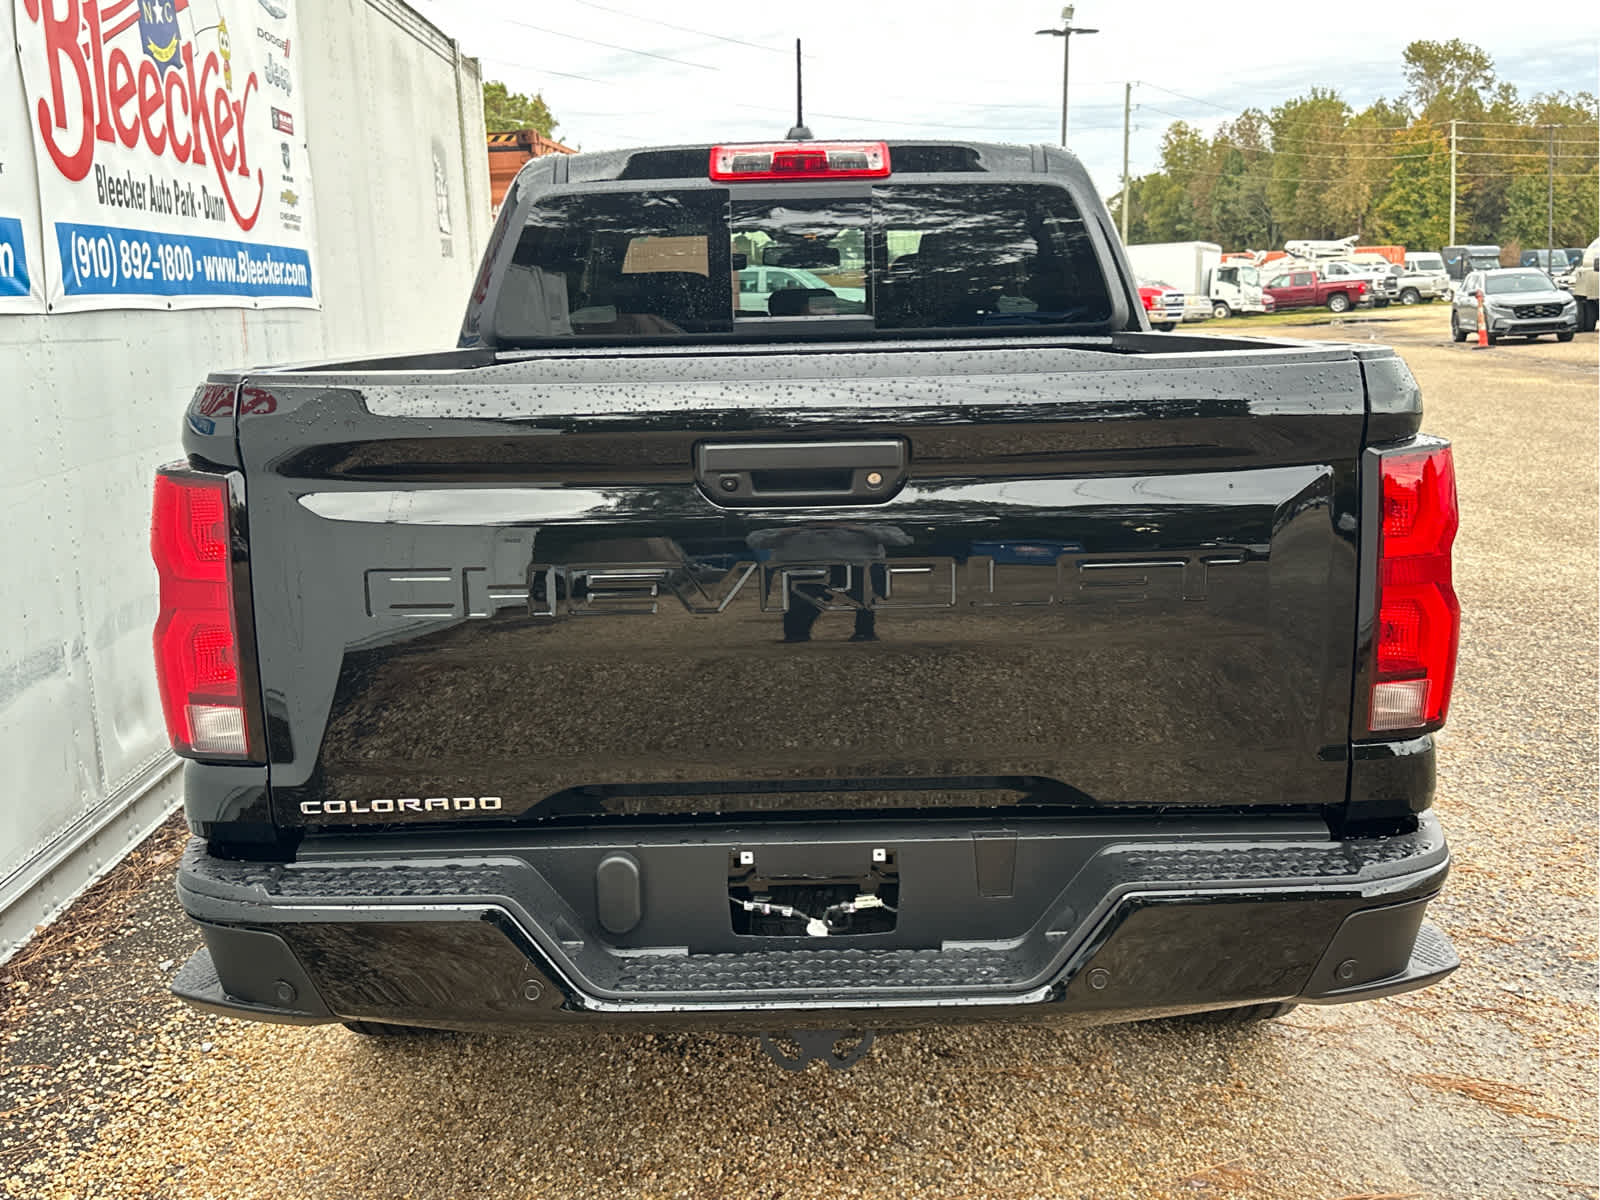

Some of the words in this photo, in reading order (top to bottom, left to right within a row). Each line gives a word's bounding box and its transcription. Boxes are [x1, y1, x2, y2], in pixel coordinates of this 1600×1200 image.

[256, 27, 288, 50] DODGE
[264, 52, 292, 97] Jeep
[95, 164, 147, 211] Bleecker
[150, 175, 172, 214] Auto
[173, 179, 198, 218] Park
[202, 185, 226, 222] Dunn
[71, 231, 118, 288] (910)
[120, 239, 194, 281] 892-1800
[203, 250, 308, 287] www.Bleecker.com
[364, 549, 1247, 619] CHEVROLET
[300, 797, 502, 814] COLORADO
